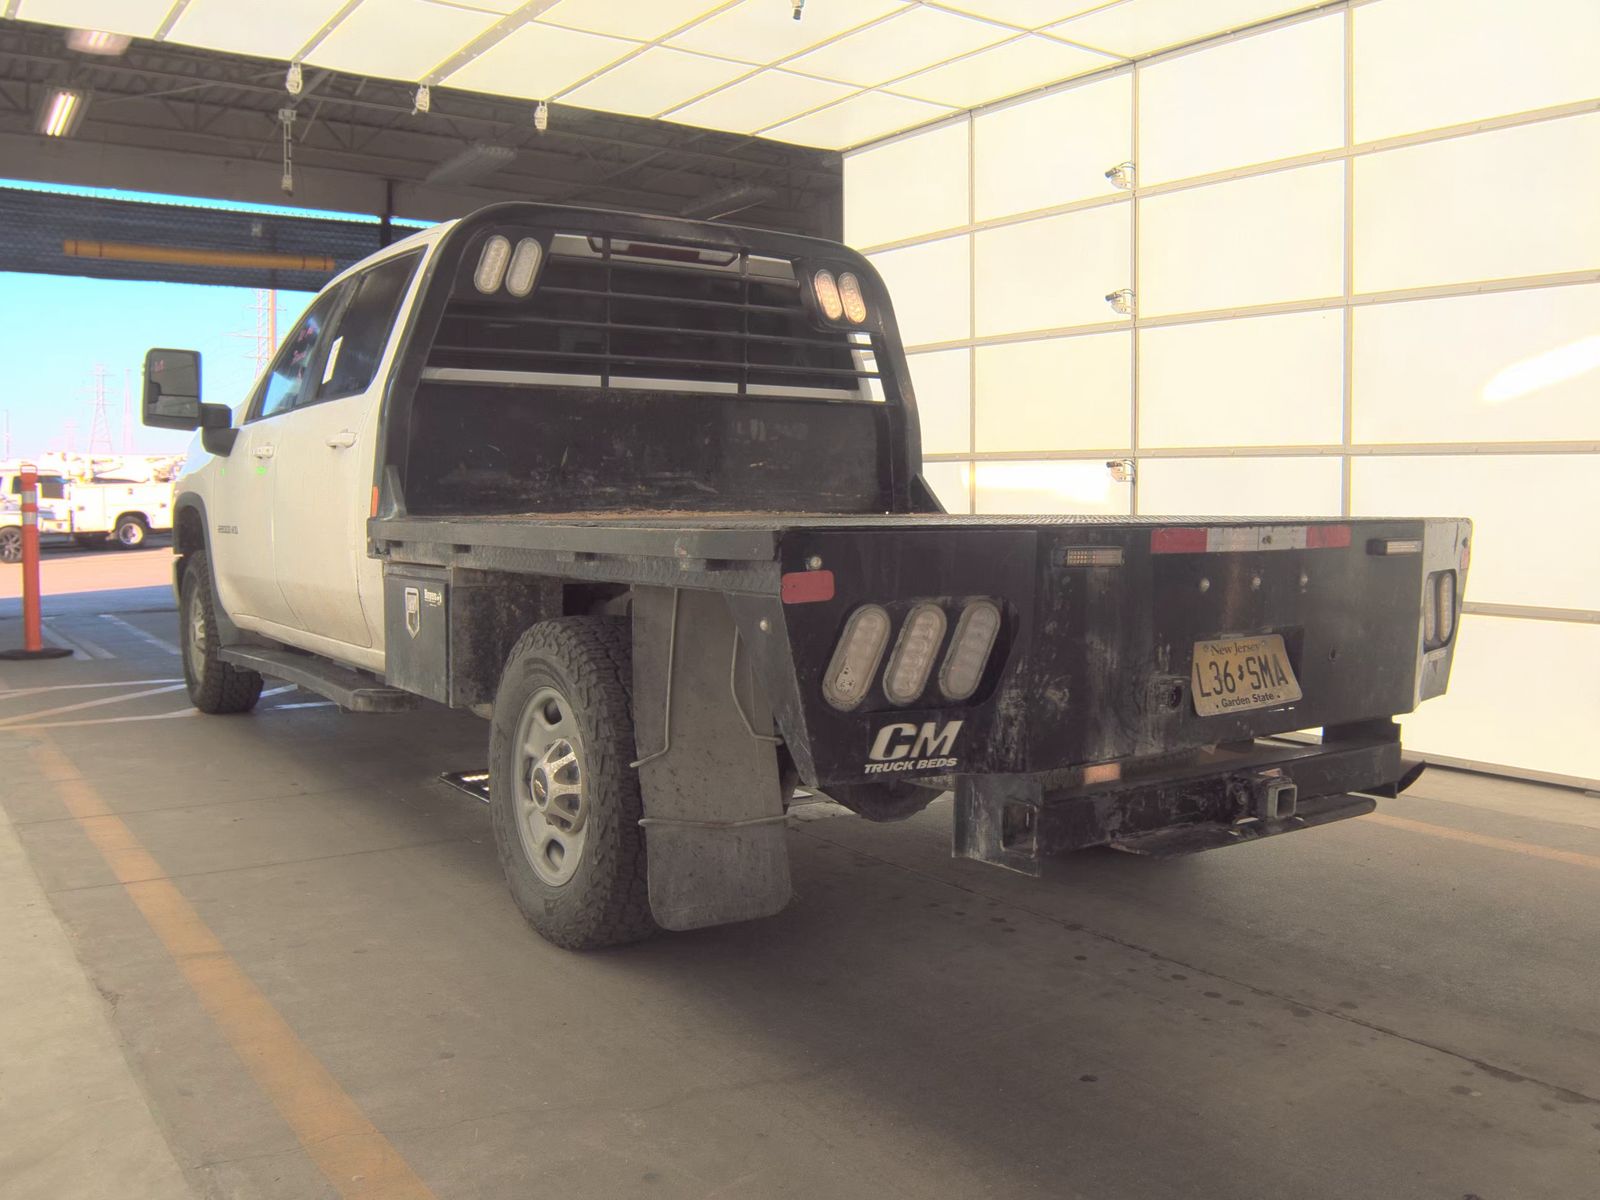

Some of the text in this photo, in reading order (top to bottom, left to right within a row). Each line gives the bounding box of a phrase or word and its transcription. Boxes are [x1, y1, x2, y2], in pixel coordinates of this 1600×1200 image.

[1211, 644, 1232, 656] New
[1196, 661, 1236, 698] L36
[1221, 692, 1275, 709] Garden State
[868, 720, 964, 761] CM
[864, 757, 959, 774] TRUCK BEDS
